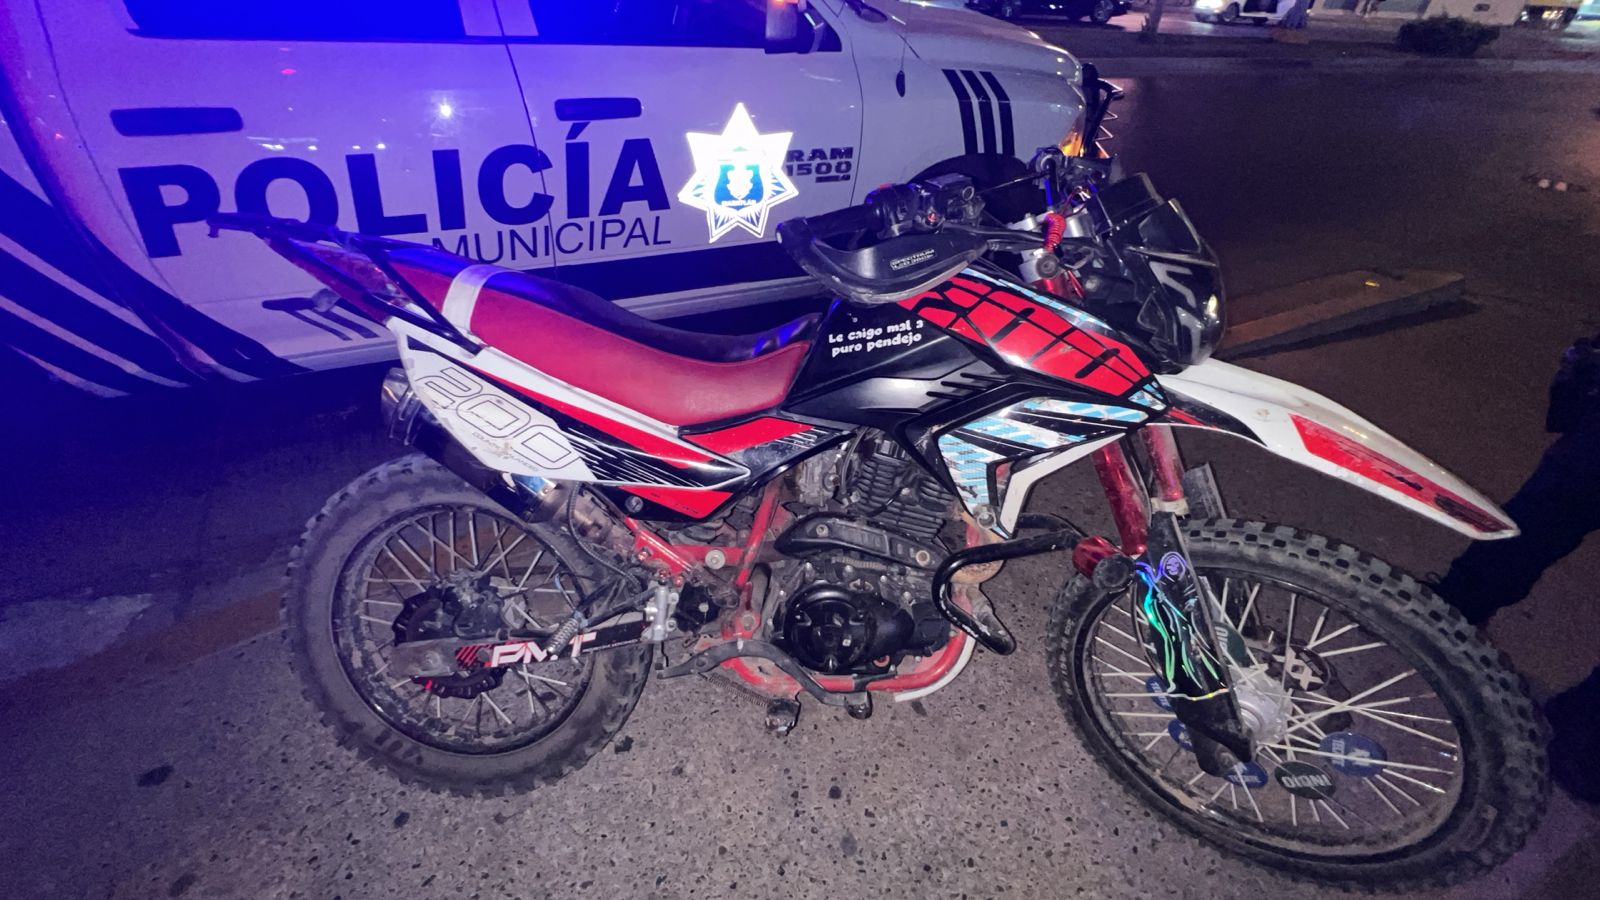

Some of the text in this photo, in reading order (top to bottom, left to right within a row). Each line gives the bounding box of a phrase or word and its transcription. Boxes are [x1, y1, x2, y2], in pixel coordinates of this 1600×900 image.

[786, 147, 854, 162] RAM
[786, 161, 852, 176] 1500
[117, 121, 671, 258] POLICÍA
[432, 215, 671, 264] MUNICIPAL
[828, 333, 844, 343] Le
[847, 327, 883, 341] caigo
[886, 320, 912, 333] mal
[832, 332, 922, 358] puro pendejo
[415, 367, 585, 470] 200
